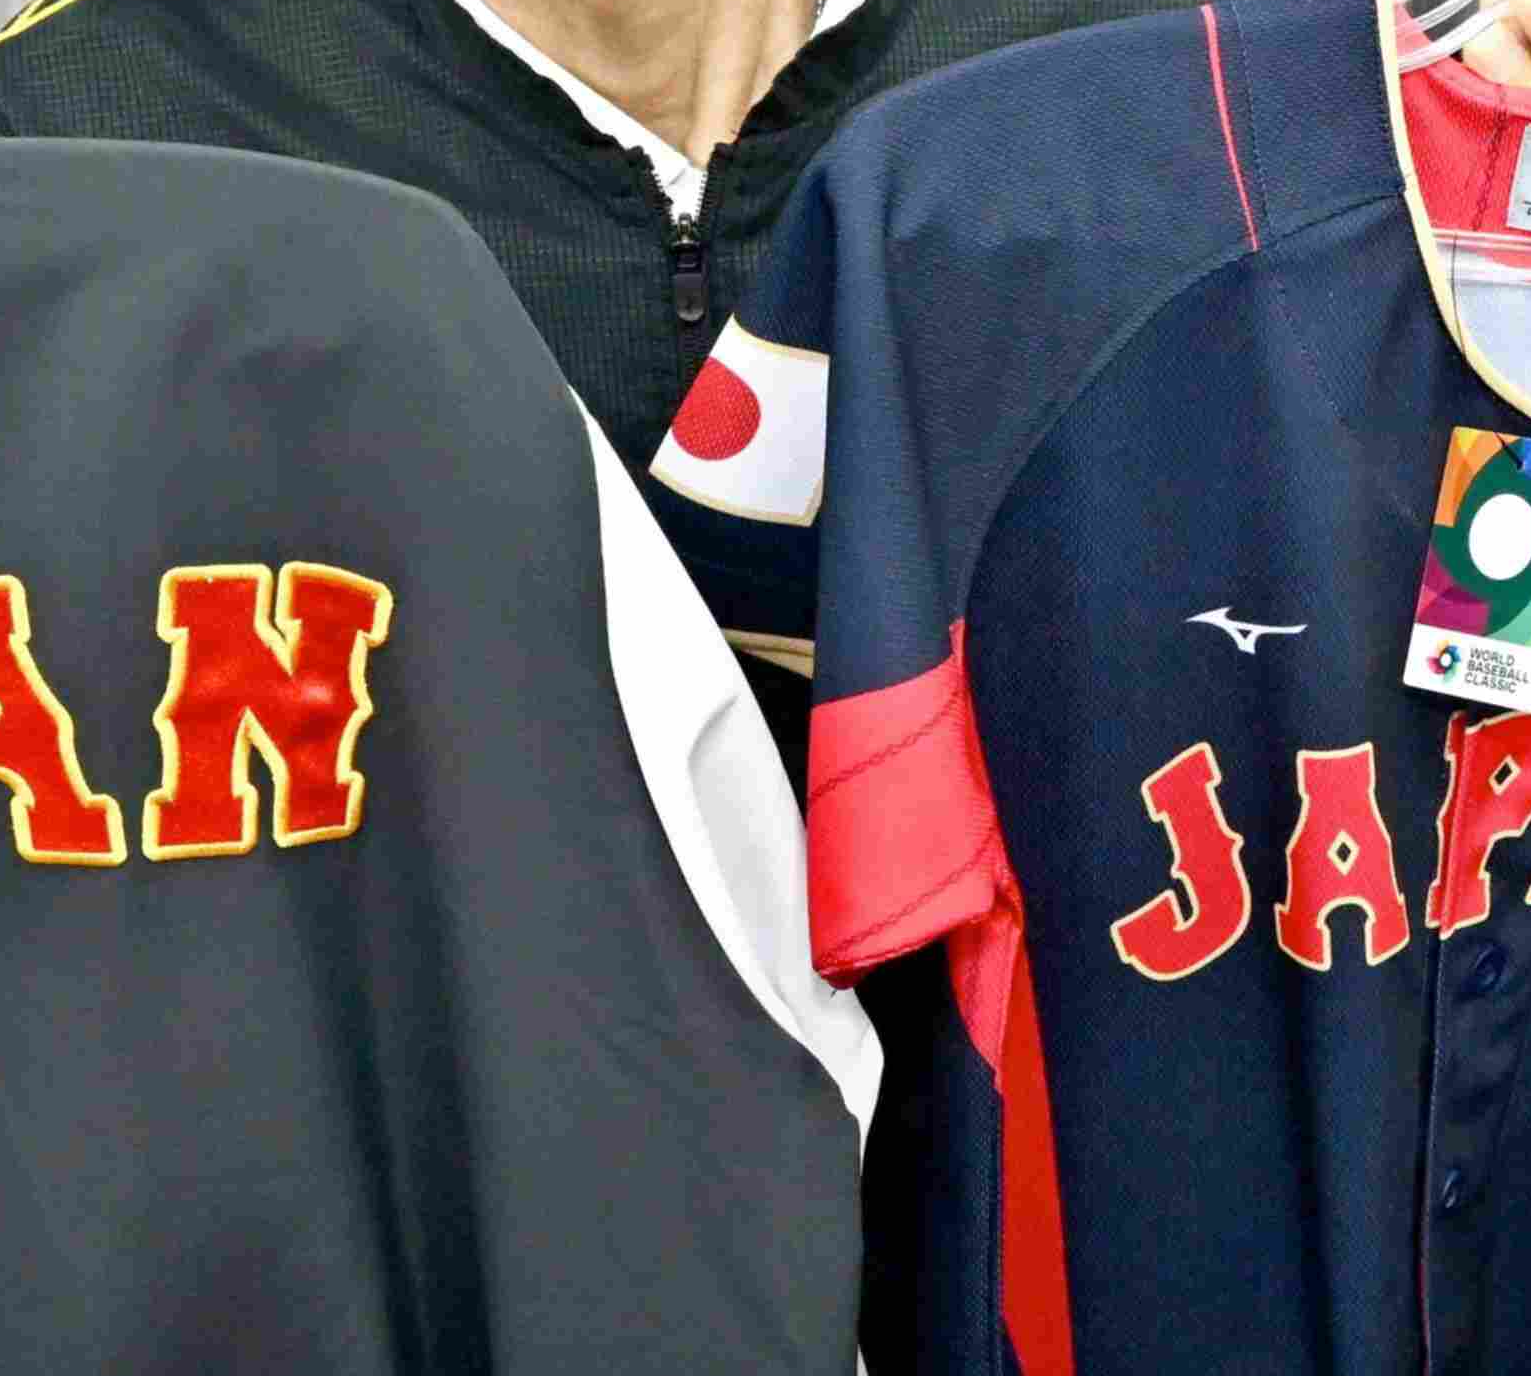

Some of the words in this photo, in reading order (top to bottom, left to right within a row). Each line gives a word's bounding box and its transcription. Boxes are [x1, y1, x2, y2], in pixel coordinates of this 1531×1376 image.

[1469, 647, 1515, 667] WORLD
[1463, 671, 1518, 694] CLASSIC
[1466, 659, 1530, 684] BASEBALL
